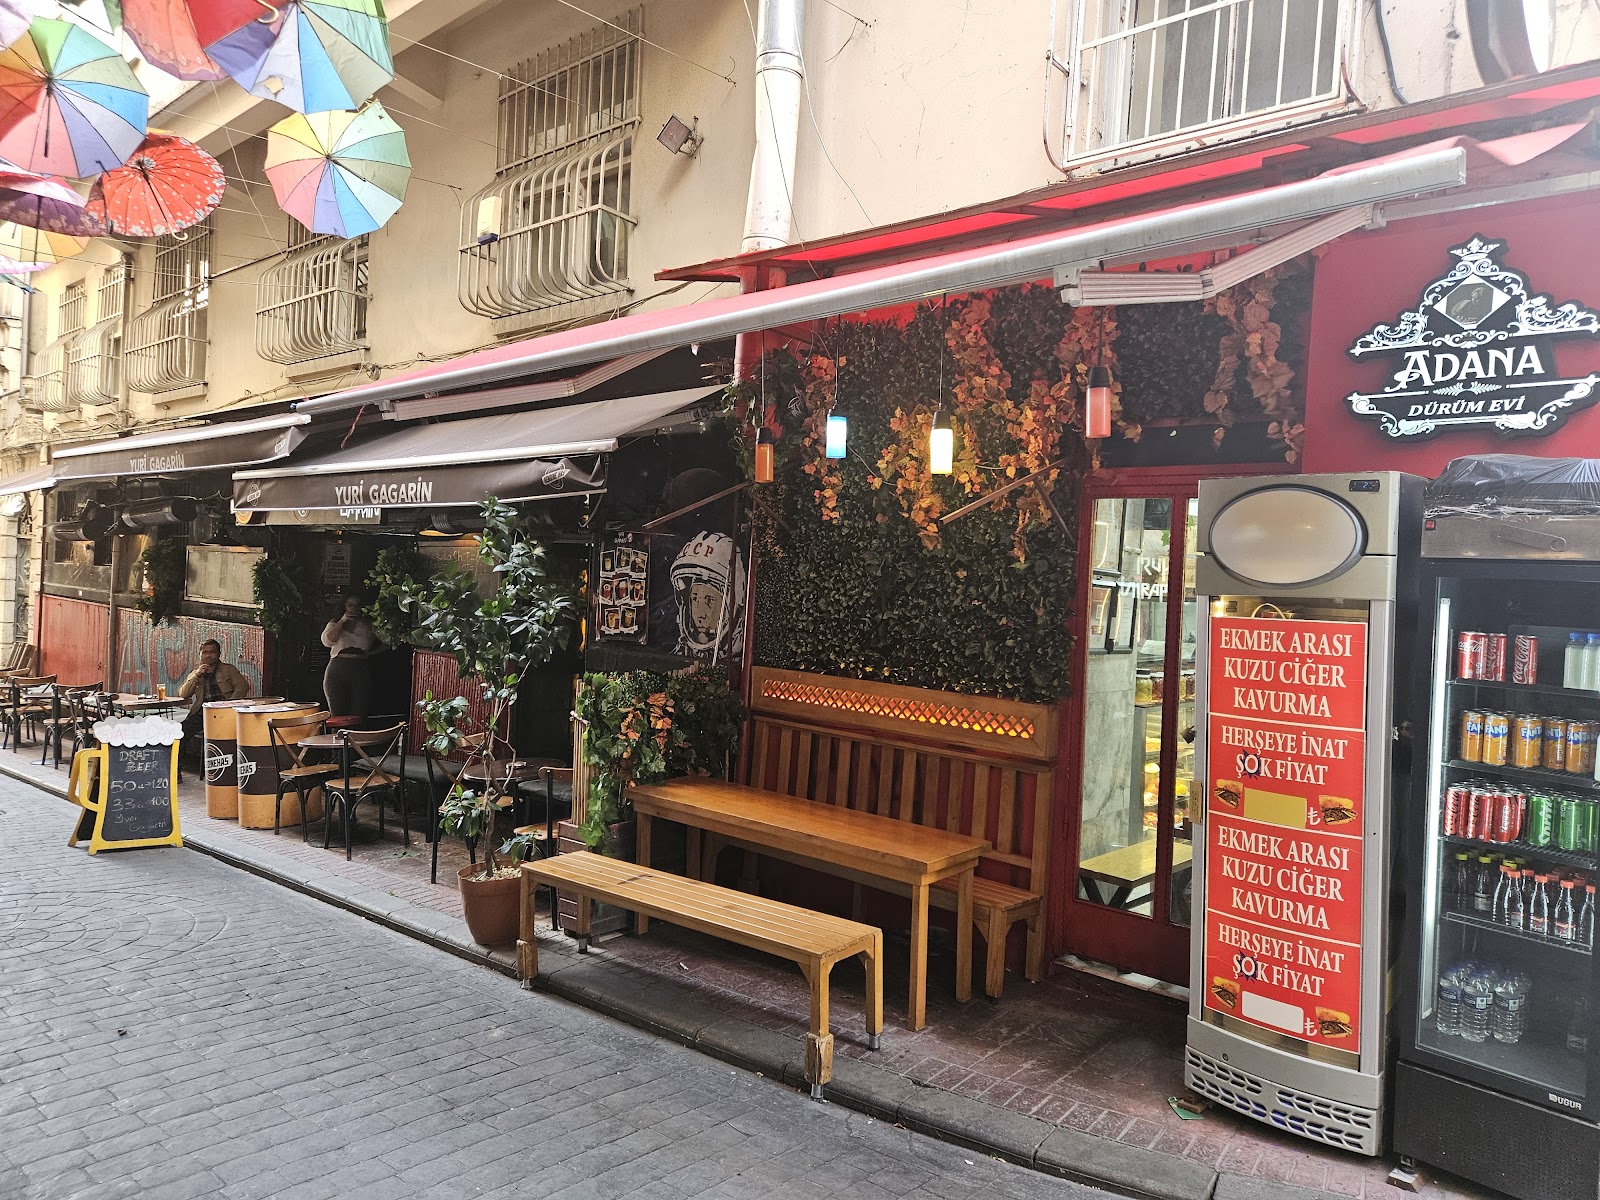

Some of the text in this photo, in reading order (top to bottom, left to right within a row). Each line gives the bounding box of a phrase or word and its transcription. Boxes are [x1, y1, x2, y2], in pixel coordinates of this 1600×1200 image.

[1384, 346, 1545, 392] ADANA
[1408, 395, 1526, 417] DÜRÜM EVİ
[130, 450, 185, 473] YURİ GAGARİN
[335, 476, 433, 506] YURİ GAGARİN
[1220, 627, 1352, 657] EKMEK ARASI
[1223, 657, 1347, 688] KUZU CİĞER
[1233, 687, 1332, 718] KAVURMA
[120, 749, 160, 762] DRAFT
[1221, 725, 1348, 760] HERŞEYE İNAT
[125, 761, 158, 773] BEER
[1235, 754, 1328, 785] ŞOK FİYAT
[1218, 825, 1350, 871] EKMEK ARASI
[1222, 855, 1344, 901] KUZU CİĞER
[1231, 887, 1330, 930] KAVURMA
[1218, 923, 1344, 973] HERŞEYE İNAT
[1232, 954, 1325, 997] ŞOK FİYAT
